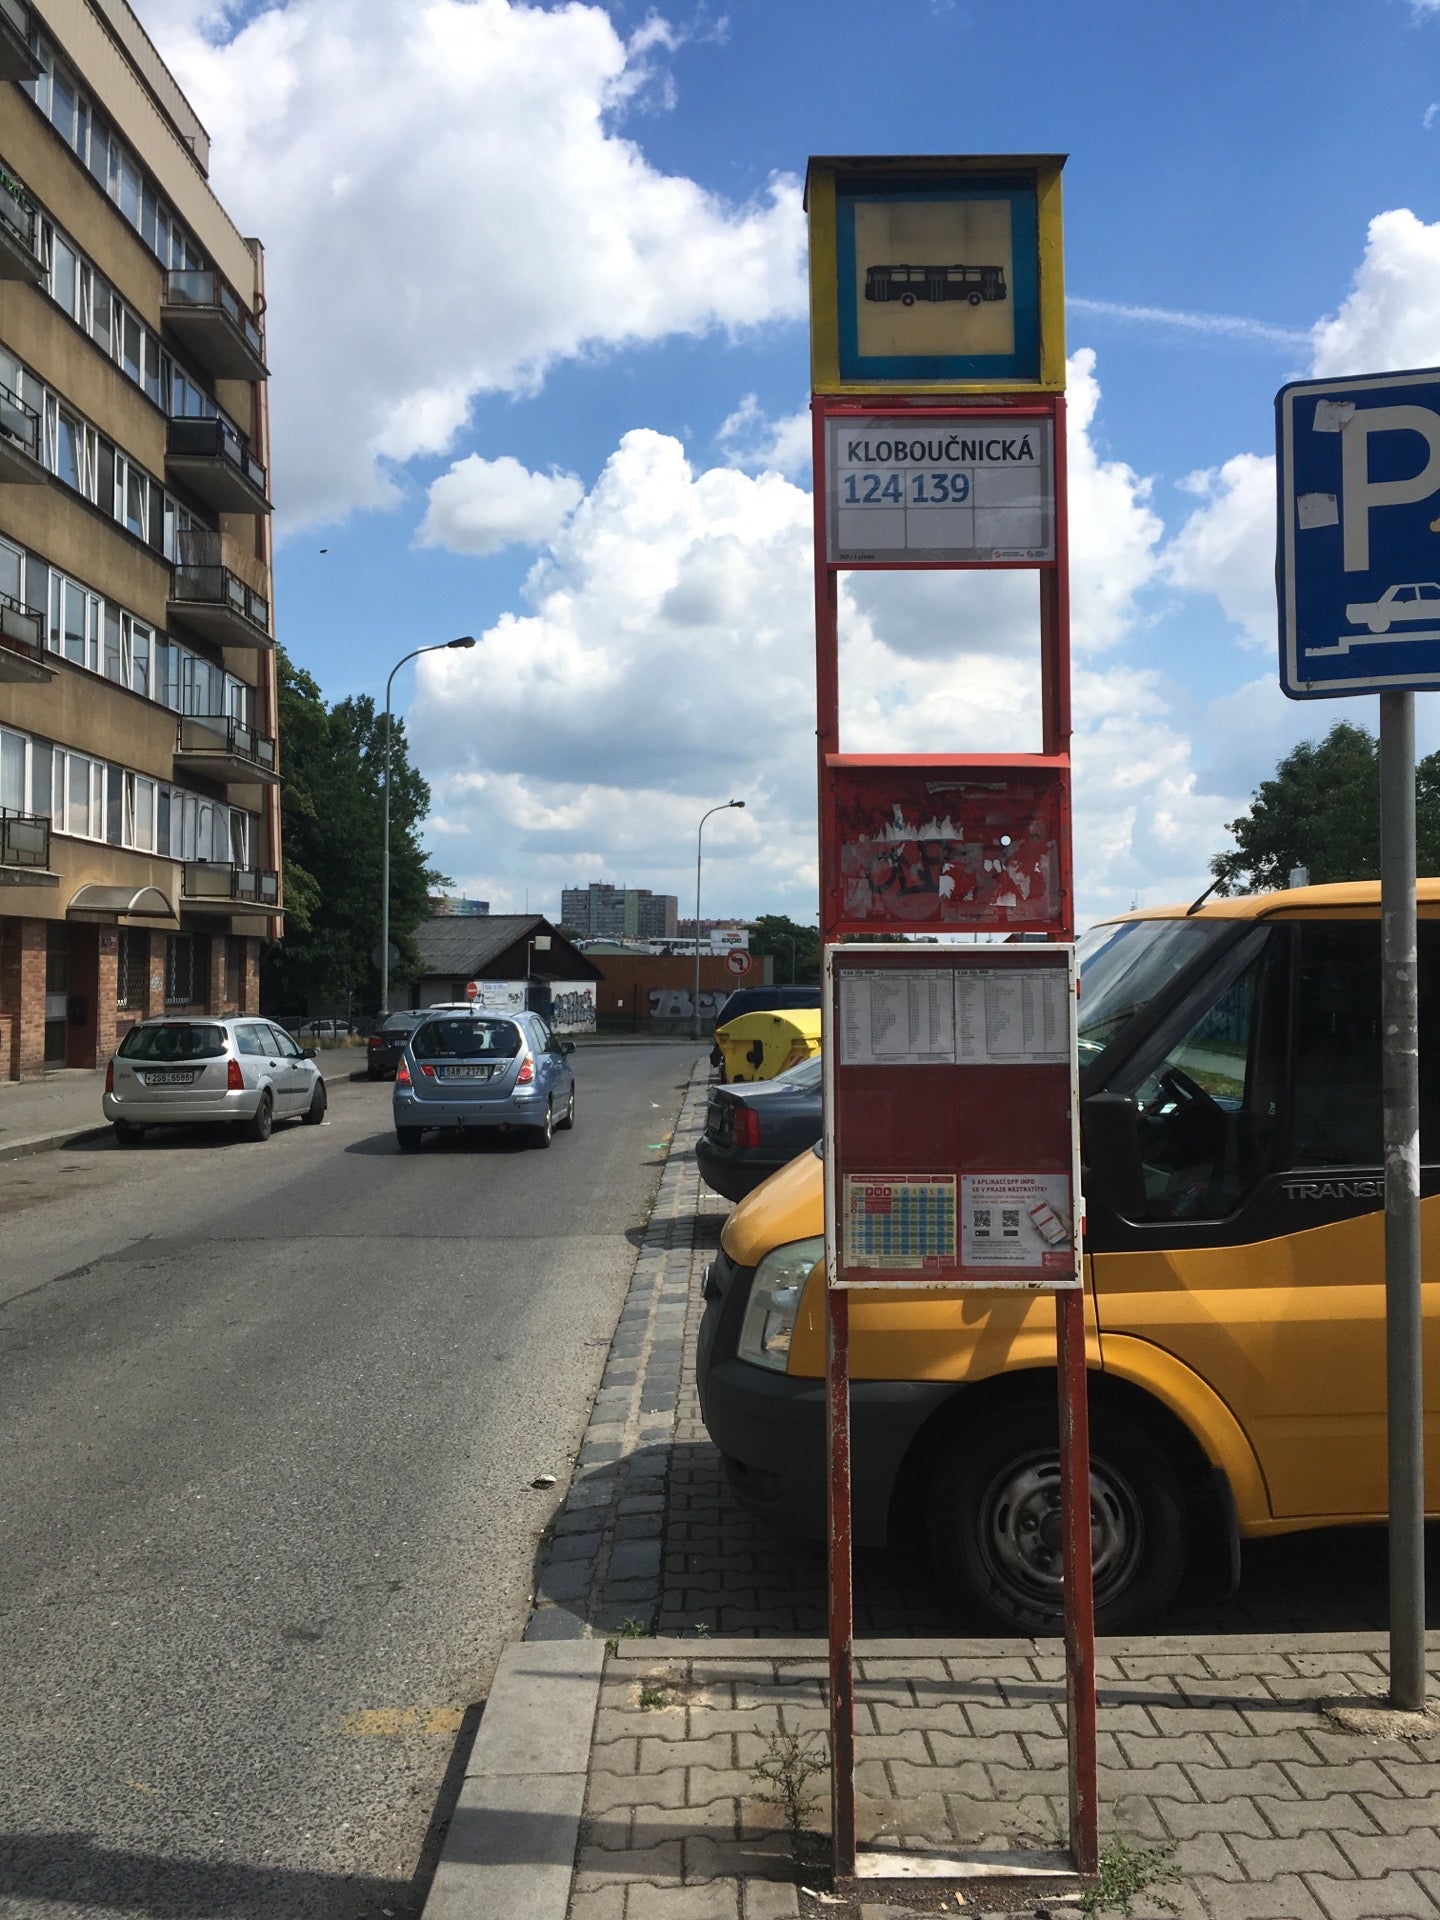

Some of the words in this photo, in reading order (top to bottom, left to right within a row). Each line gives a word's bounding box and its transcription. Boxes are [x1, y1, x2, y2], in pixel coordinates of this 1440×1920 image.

[847, 434, 1034, 462] KLOBOUČNICKÁ
[844, 473, 903, 504] 124
[912, 473, 970, 503] 139
[1342, 405, 1440, 572] P
[1282, 1181, 1384, 1200] TRANSI
